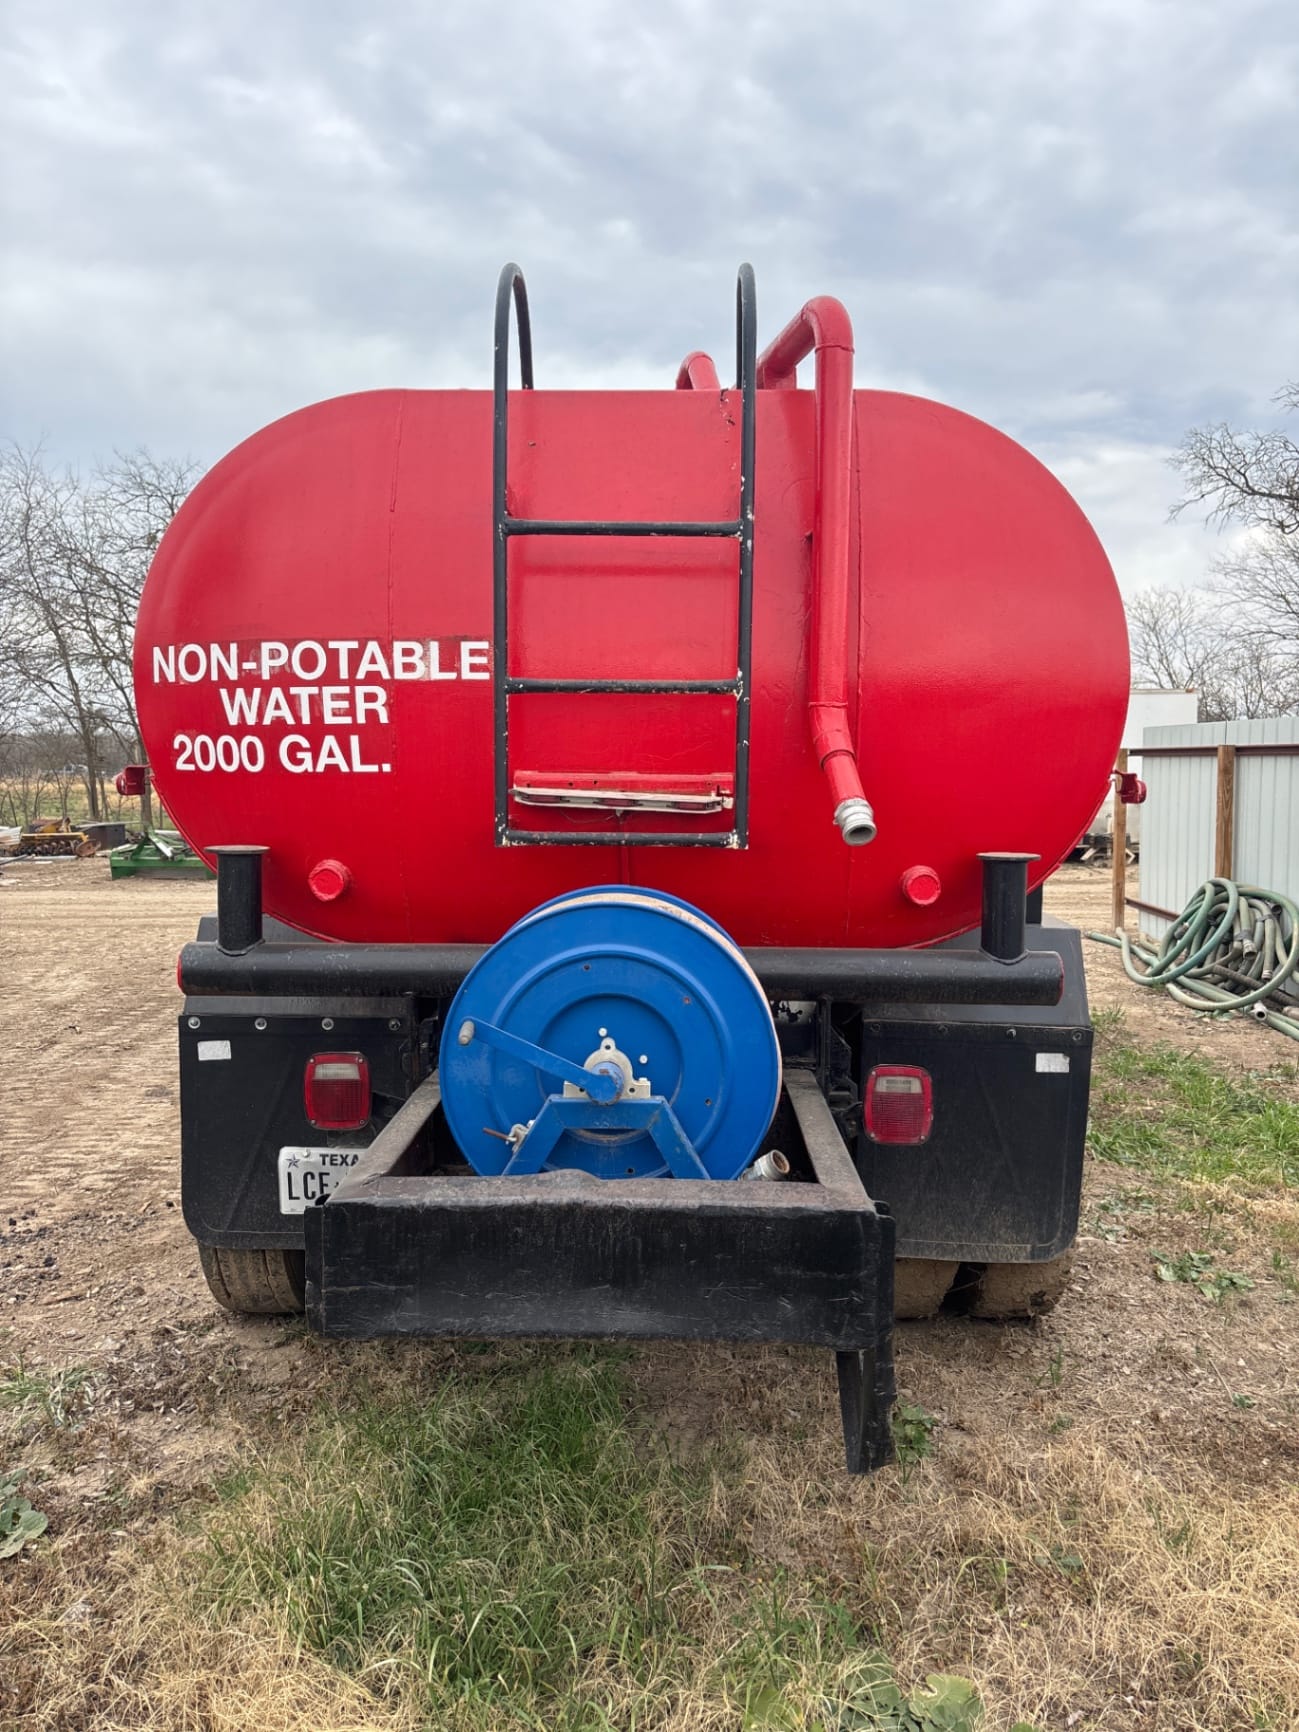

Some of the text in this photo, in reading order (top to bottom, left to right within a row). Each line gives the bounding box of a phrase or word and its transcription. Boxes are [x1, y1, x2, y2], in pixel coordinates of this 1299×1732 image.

[153, 641, 490, 683] NON-POTABLE
[220, 686, 389, 726] WATER
[174, 735, 391, 773] 2000 GAL.
[319, 1153, 360, 1167] TEXA
